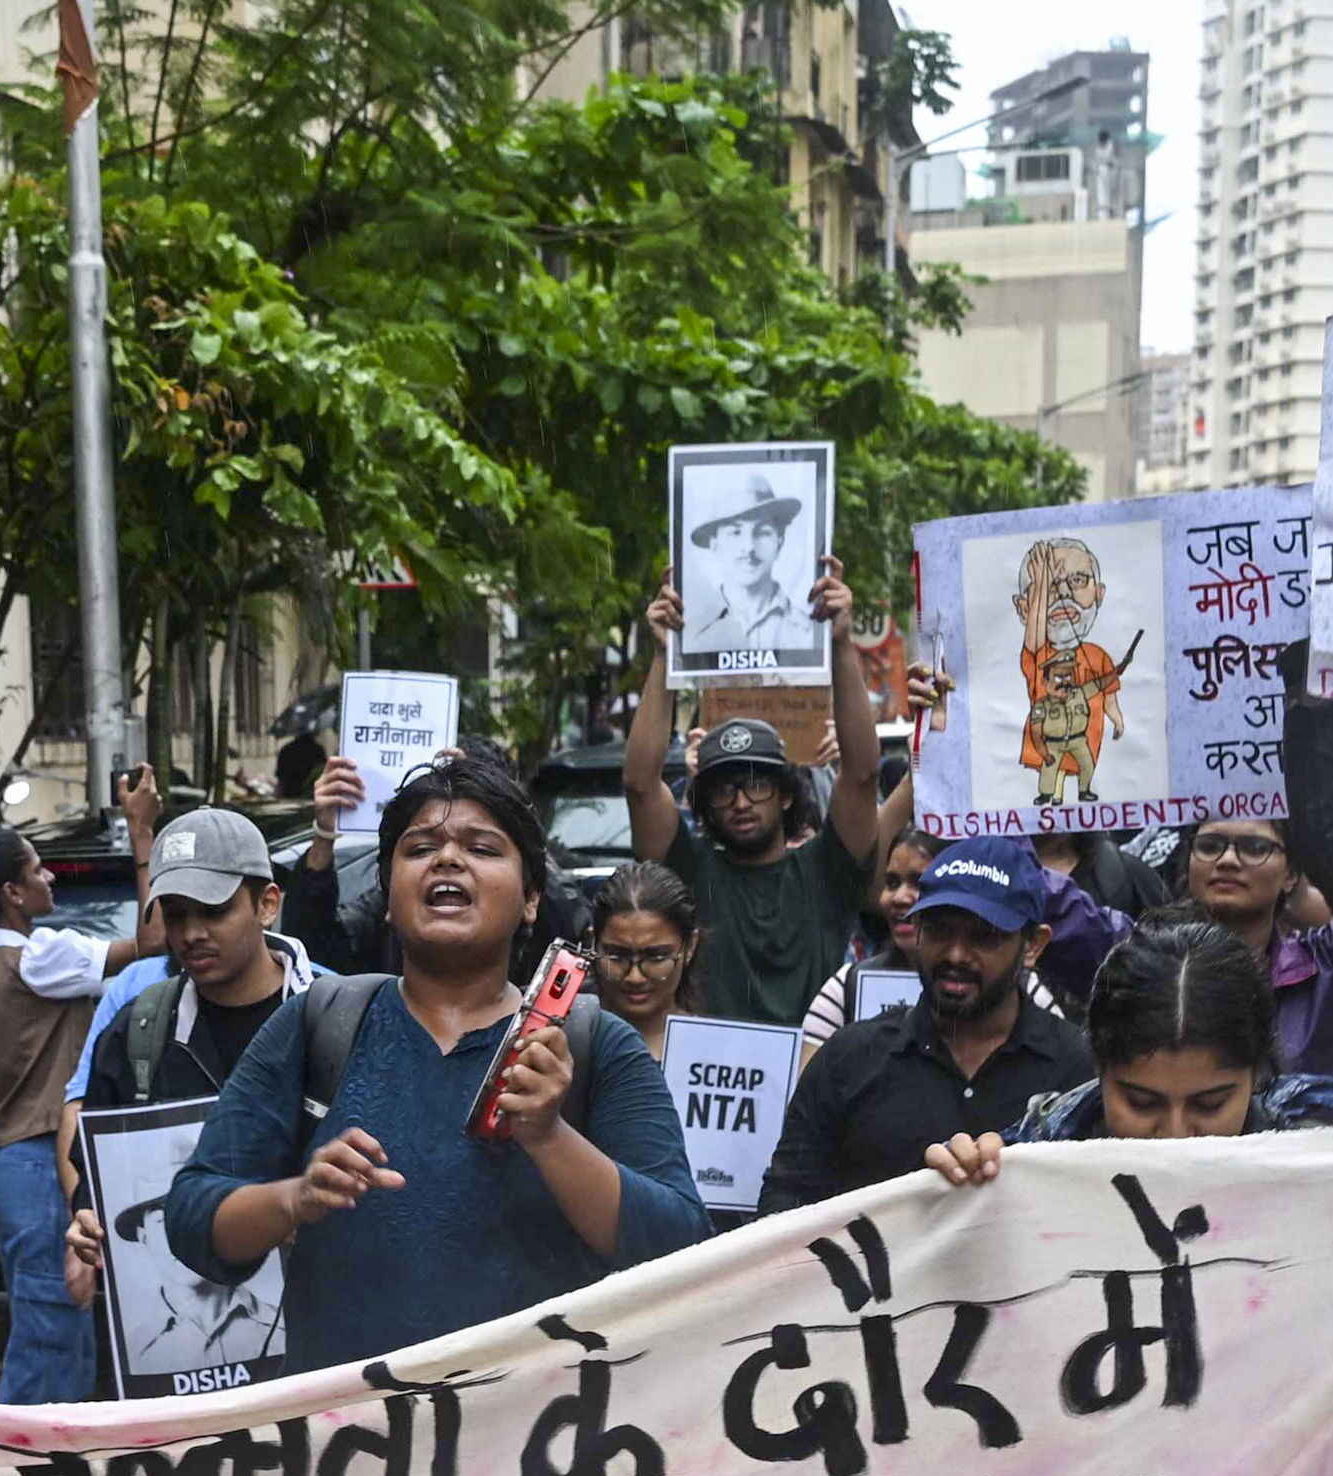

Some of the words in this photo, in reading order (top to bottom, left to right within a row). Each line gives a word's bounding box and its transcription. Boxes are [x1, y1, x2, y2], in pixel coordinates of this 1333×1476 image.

[1187, 521, 1260, 568] जब
[1189, 562, 1275, 625] मोदी
[718, 650, 778, 669] DISHA
[1182, 635, 1288, 700] पुलिस
[369, 702, 394, 717] दादा
[354, 721, 434, 747] राजीनामा
[922, 812, 1024, 837] DISHA
[1219, 792, 1286, 818] ORGA
[948, 859, 1010, 886] Columbia
[688, 1062, 764, 1091] SCRAP
[686, 1092, 757, 1133] NTA
[1059, 1173, 1228, 1419] में
[173, 1364, 251, 1394] DISHA
